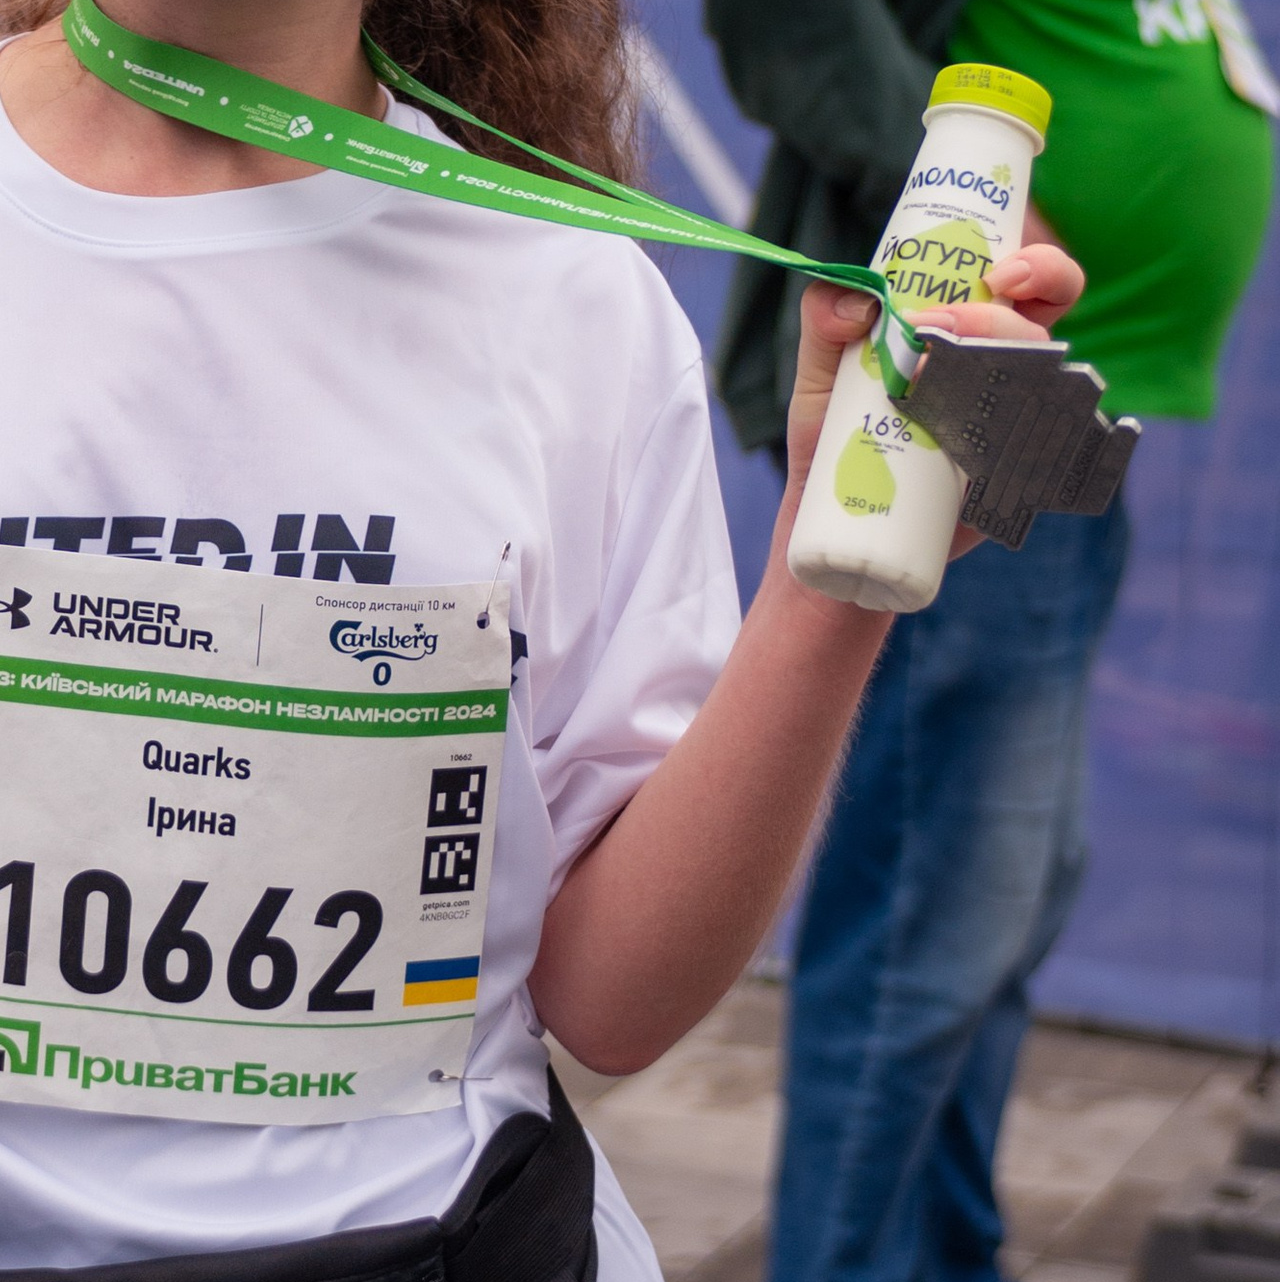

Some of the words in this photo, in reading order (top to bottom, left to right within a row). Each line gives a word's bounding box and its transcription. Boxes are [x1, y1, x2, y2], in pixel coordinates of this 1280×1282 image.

[122, 58, 205, 97] UNITED24
[344, 137, 415, 167] ПриватБанк
[455, 172, 498, 191] 2024
[905, 167, 1010, 211] МОЛОКІЯ
[881, 236, 993, 279] ЙОГУРТ
[885, 270, 972, 304] БІЛИЙ
[863, 413, 912, 442] 1,6%
[844, 496, 867, 509] 250
[271, 514, 396, 585] IN
[53, 592, 181, 626] UNDER
[315, 595, 367, 611] Спонсор
[369, 599, 424, 612] дистанції
[427, 600, 440, 610] 10
[442, 602, 455, 610] км
[329, 620, 439, 659] Carlsberg
[373, 662, 392, 686] 0
[21, 673, 151, 702] КИЇВСЬКИЙ
[156, 687, 271, 715] МАРАФОН
[276, 701, 439, 723] НЕЗЛАМНОСТІ
[444, 704, 497, 720] 2024
[142, 740, 252, 780] Quarks
[450, 754, 473, 762] 10662
[147, 797, 237, 837] Ірина
[423, 900, 470, 912] getpica.com
[43, 1042, 357, 1098] ПриватБанк
